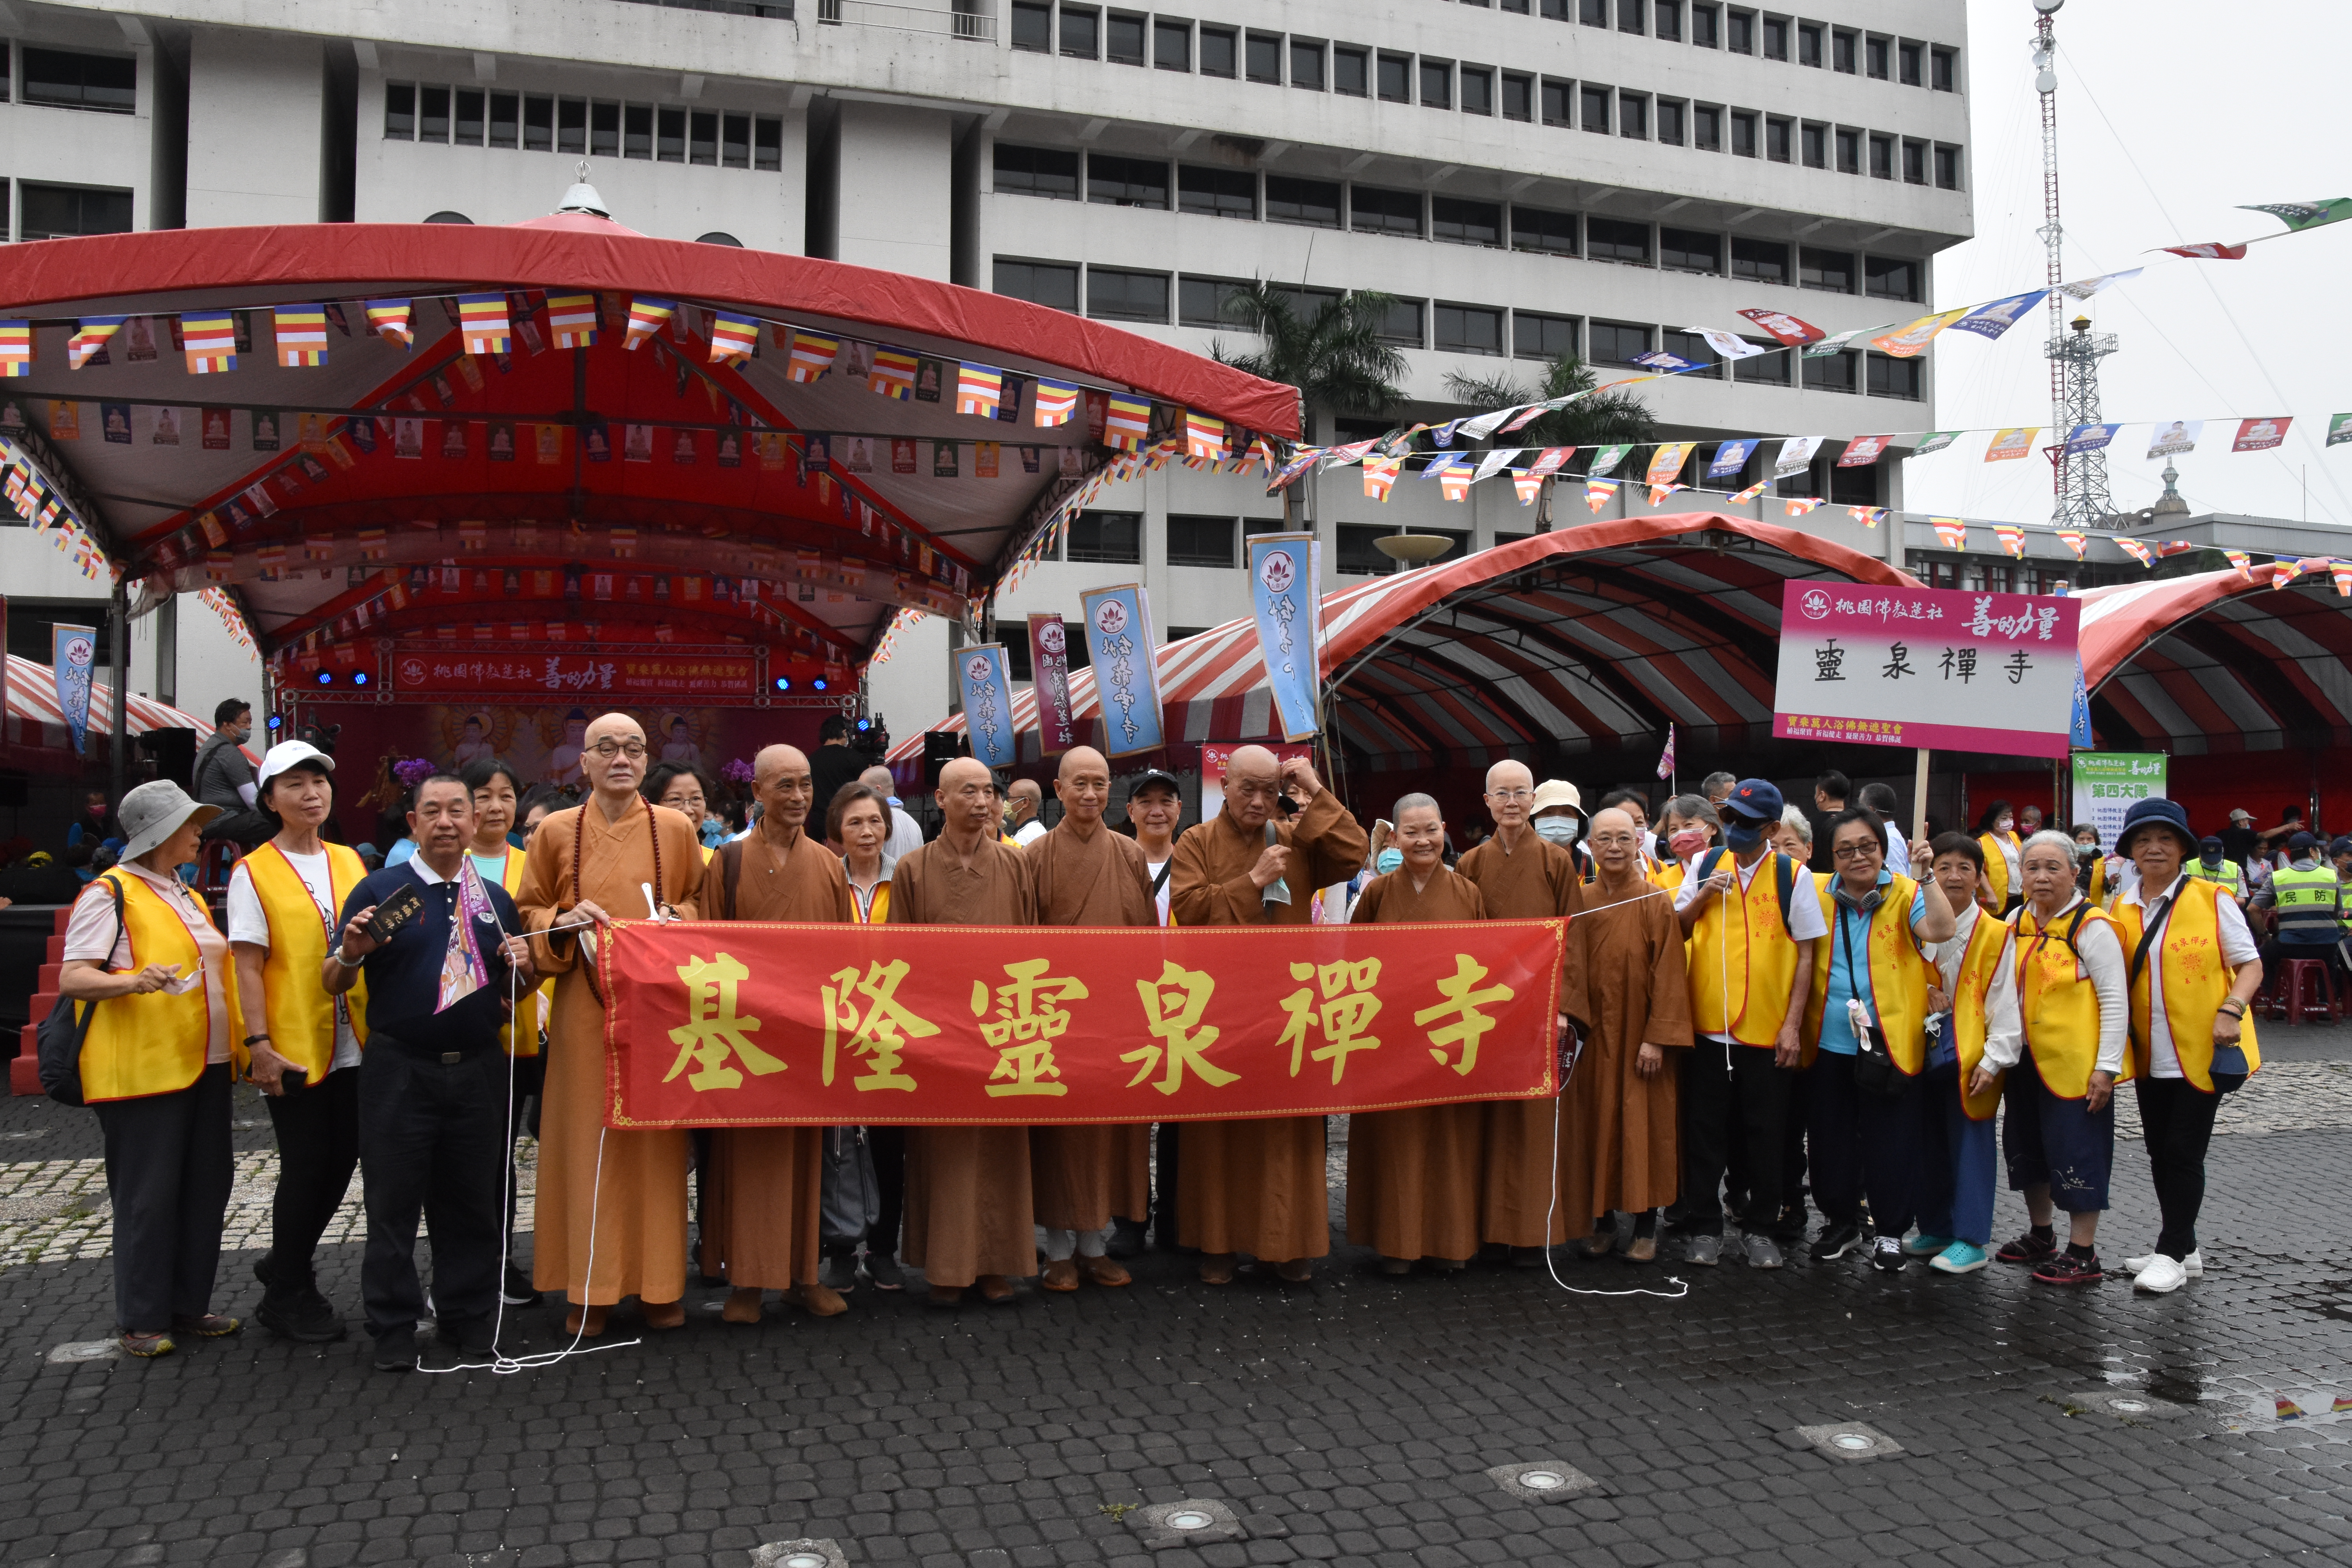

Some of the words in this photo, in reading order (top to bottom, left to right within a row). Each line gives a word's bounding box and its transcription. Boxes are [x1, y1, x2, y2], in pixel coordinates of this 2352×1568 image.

[1835, 597, 1944, 624] 桃園佛教蓮社
[1961, 595, 2060, 641] 善的力量
[433, 661, 532, 685] 桃園佛教蓮社
[536, 656, 617, 690] 善的力量
[1815, 638, 2033, 684] 靈泉禪寺
[1786, 727, 1812, 736] 植福聚寶
[1816, 729, 1842, 739] 祈福健走
[1846, 732, 1872, 741] 凝聚善力
[1875, 734, 1902, 743] 恭賀佛誕
[1788, 715, 1904, 735] 寶乘萬人浴佛無遮聖會
[2092, 783, 2148, 799] 第四大隊
[2285, 890, 2326, 903] 民防
[661, 953, 1515, 1097] 基隆靈泉禪寺
